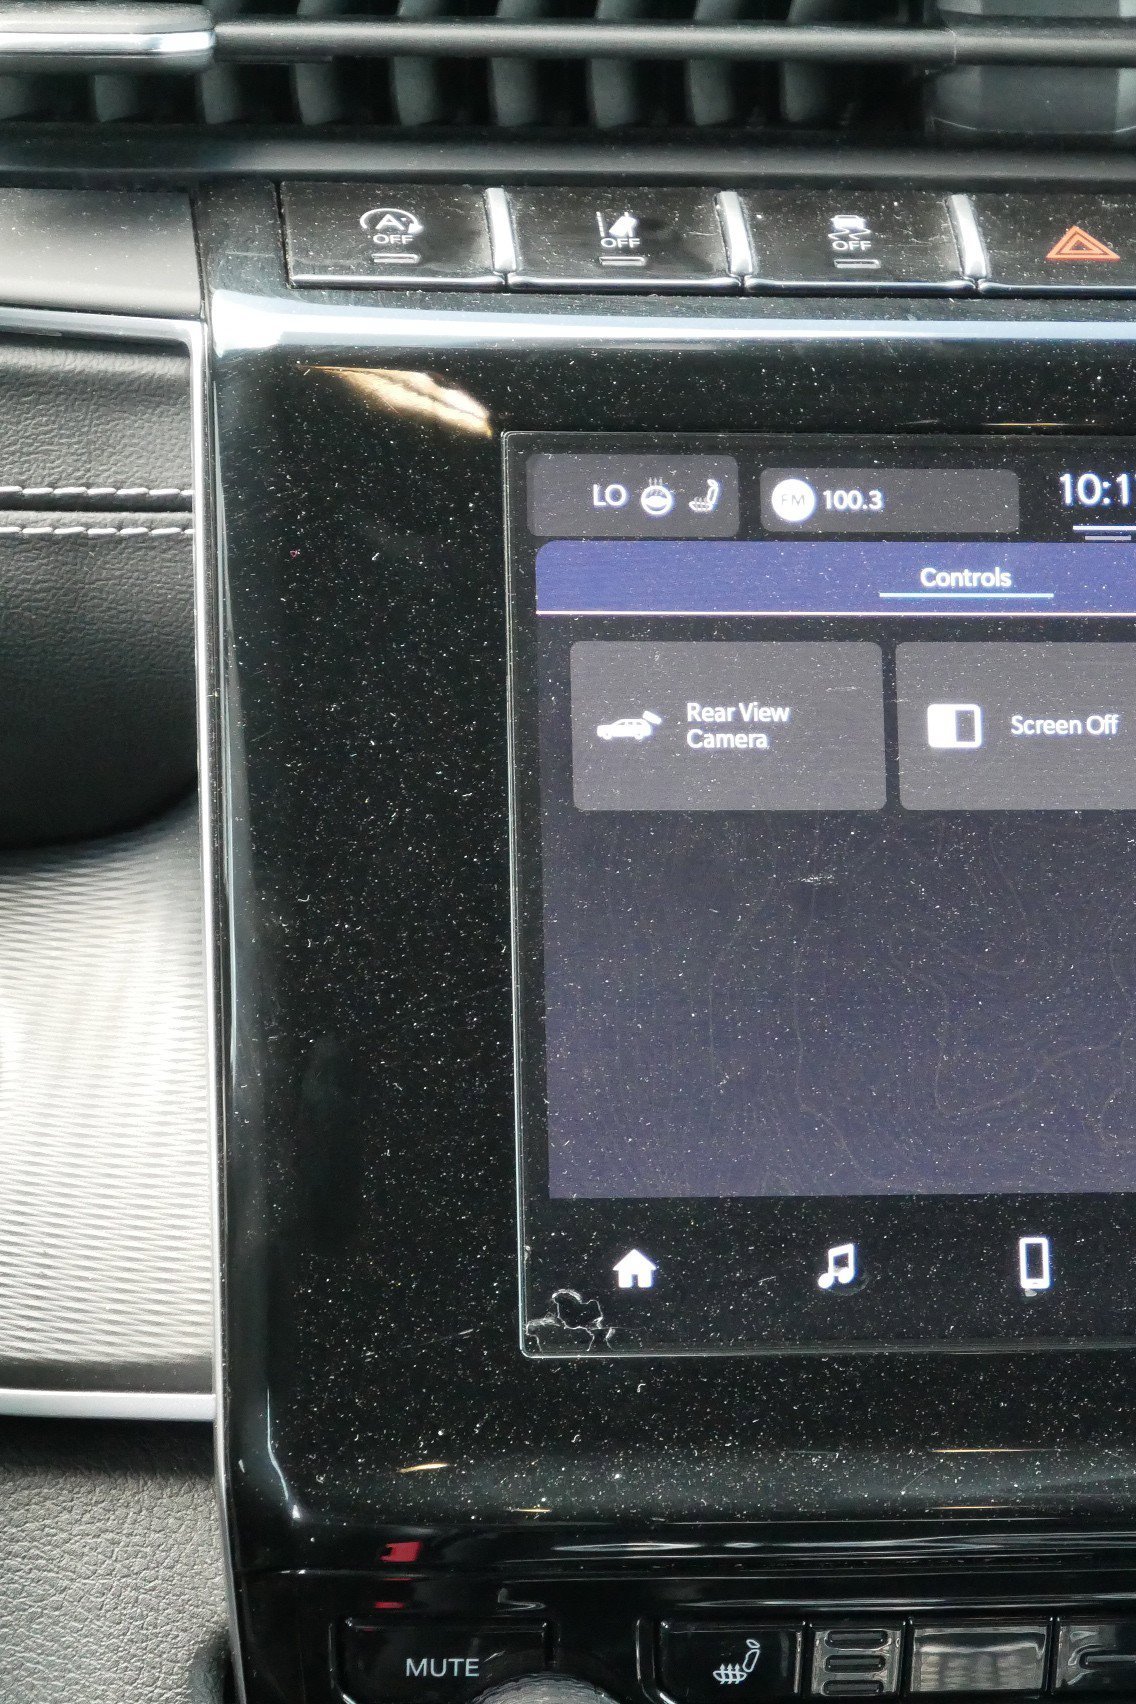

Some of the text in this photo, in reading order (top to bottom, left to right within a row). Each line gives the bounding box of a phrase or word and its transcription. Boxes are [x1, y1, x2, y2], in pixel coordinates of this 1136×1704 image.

[375, 213, 405, 231] A
[372, 234, 413, 245] OFF
[600, 238, 641, 248] OFF
[832, 240, 872, 251] OFF
[592, 484, 628, 507] LO
[781, 489, 884, 512] FM 100.3
[919, 566, 1013, 588] Controls
[685, 702, 791, 723] Rear View
[1010, 714, 1119, 736] Screen Off
[685, 729, 769, 749] Camera
[405, 1657, 480, 1677] MUTE
